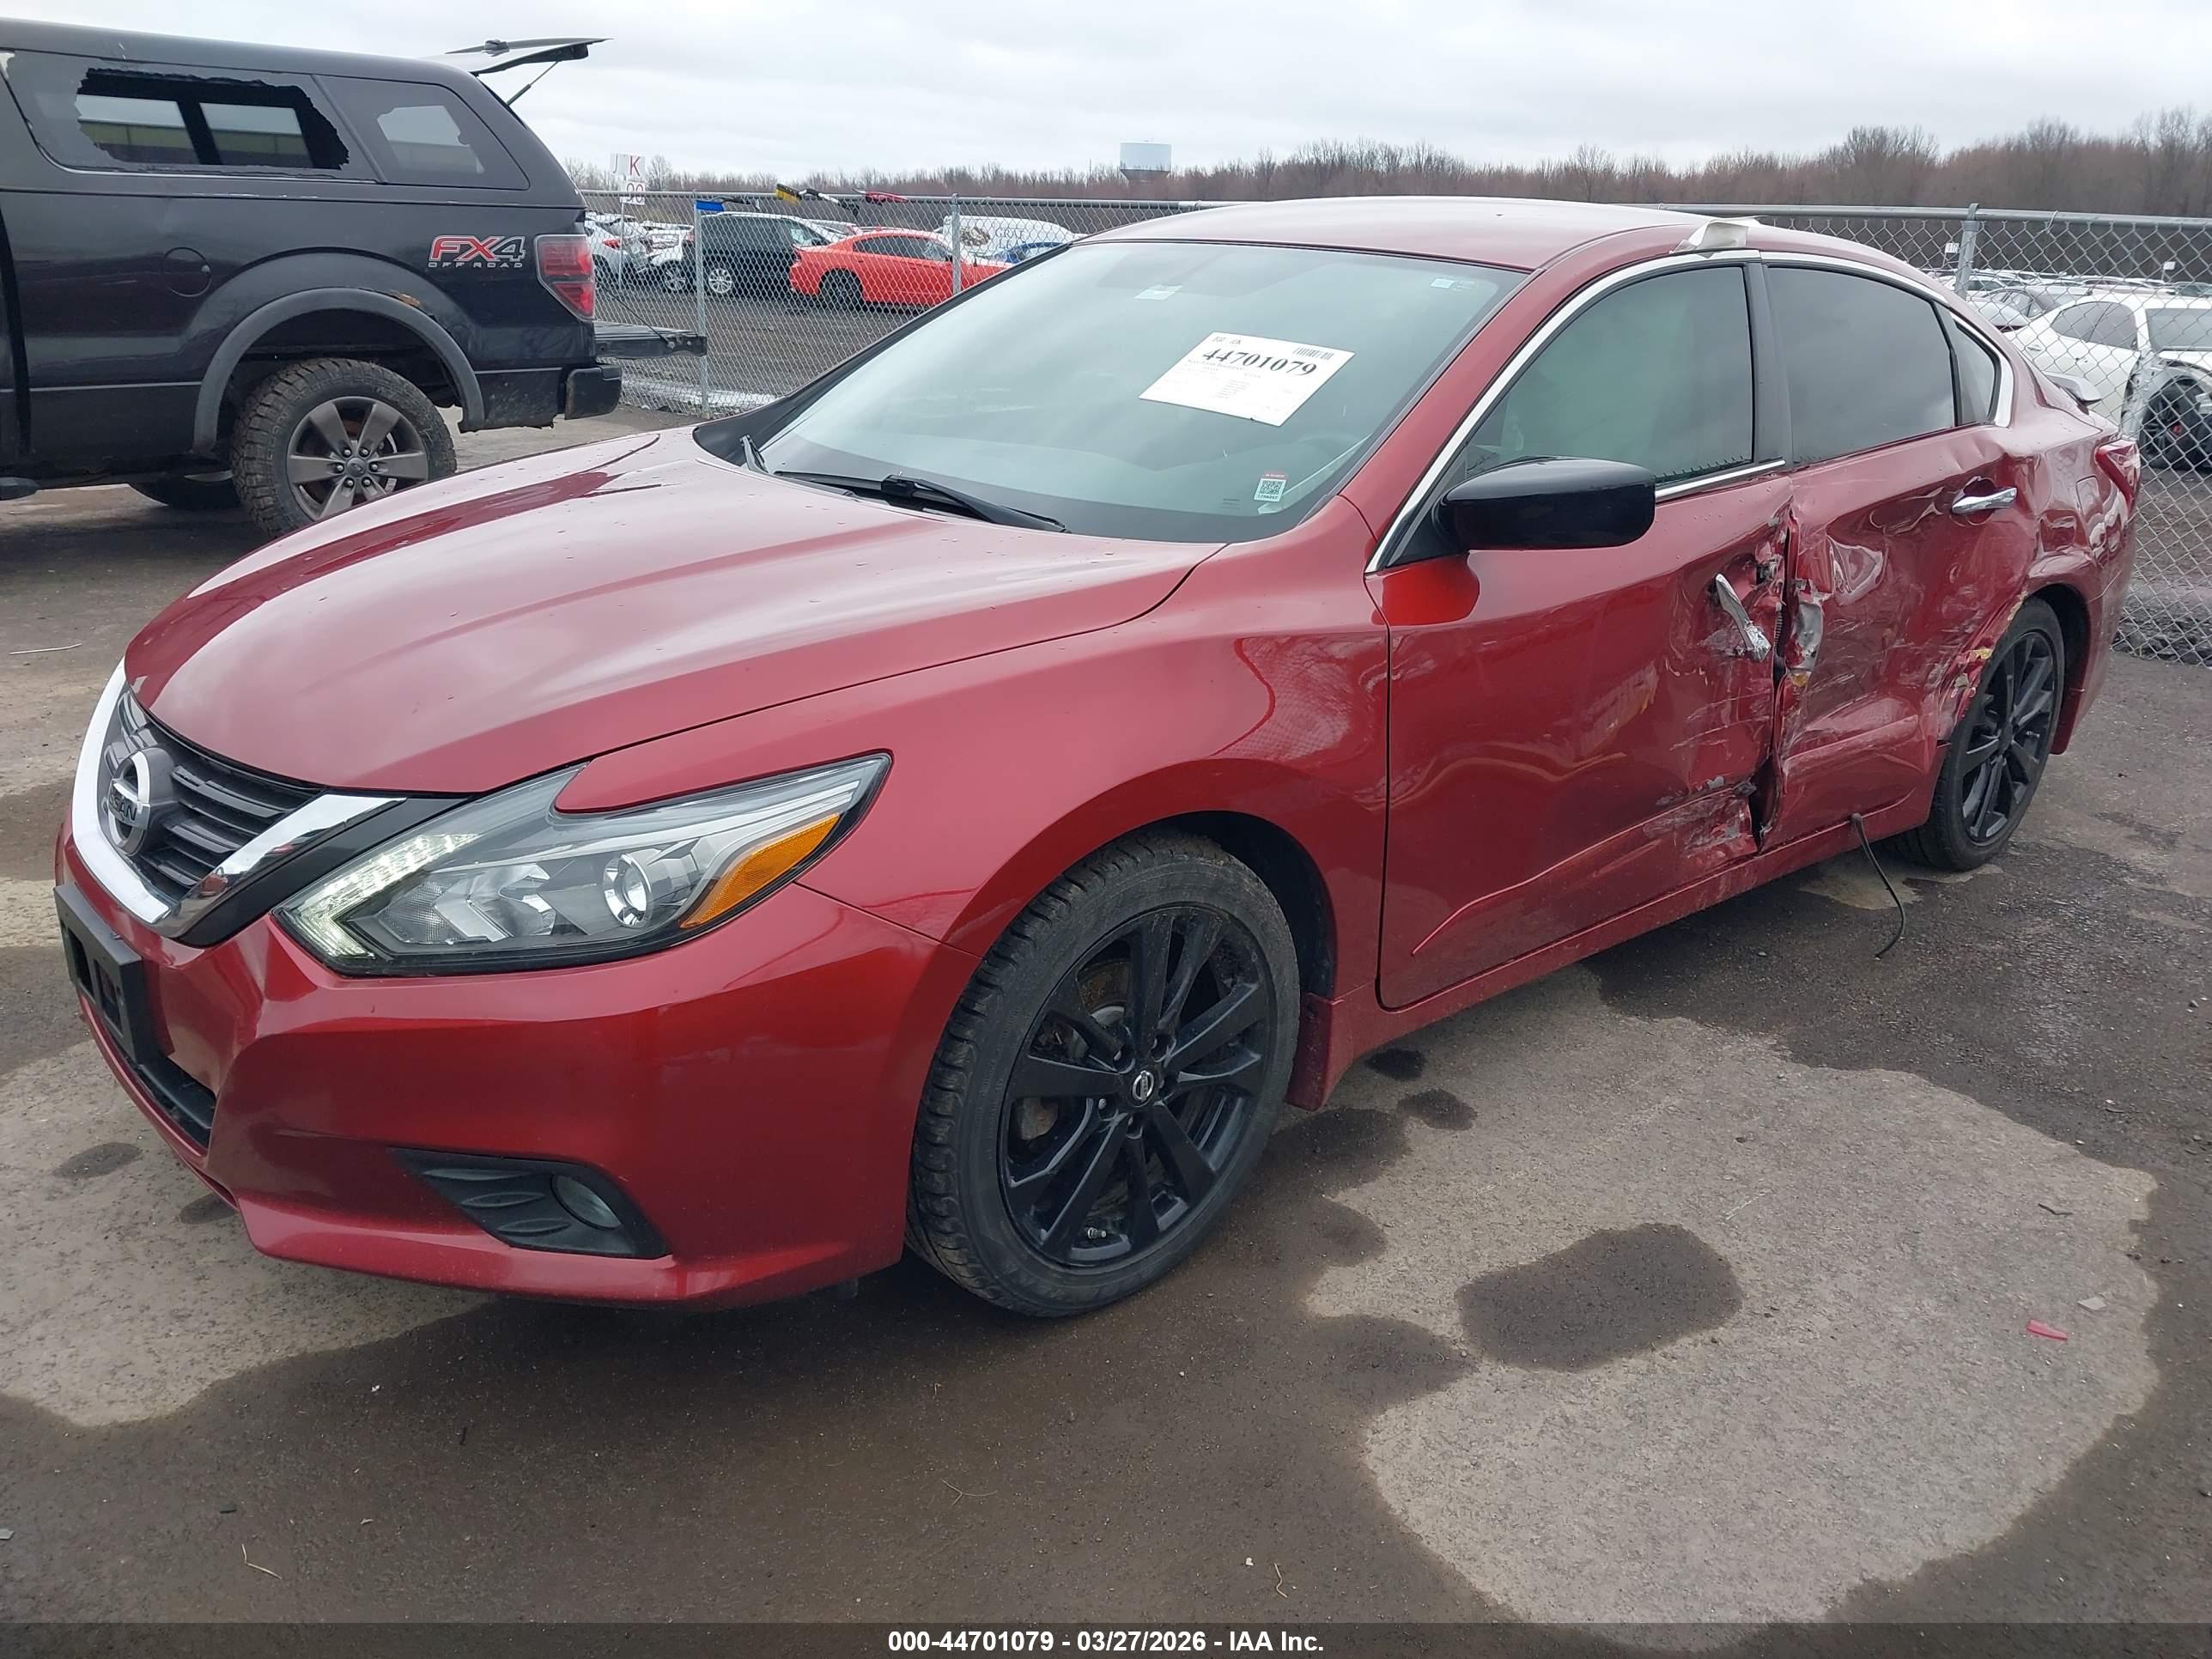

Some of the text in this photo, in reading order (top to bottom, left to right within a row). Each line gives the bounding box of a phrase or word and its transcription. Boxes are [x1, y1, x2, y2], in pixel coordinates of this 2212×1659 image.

[629, 155, 641, 177] K
[429, 235, 526, 262] FX4
[1202, 348, 1317, 376] 44701079
